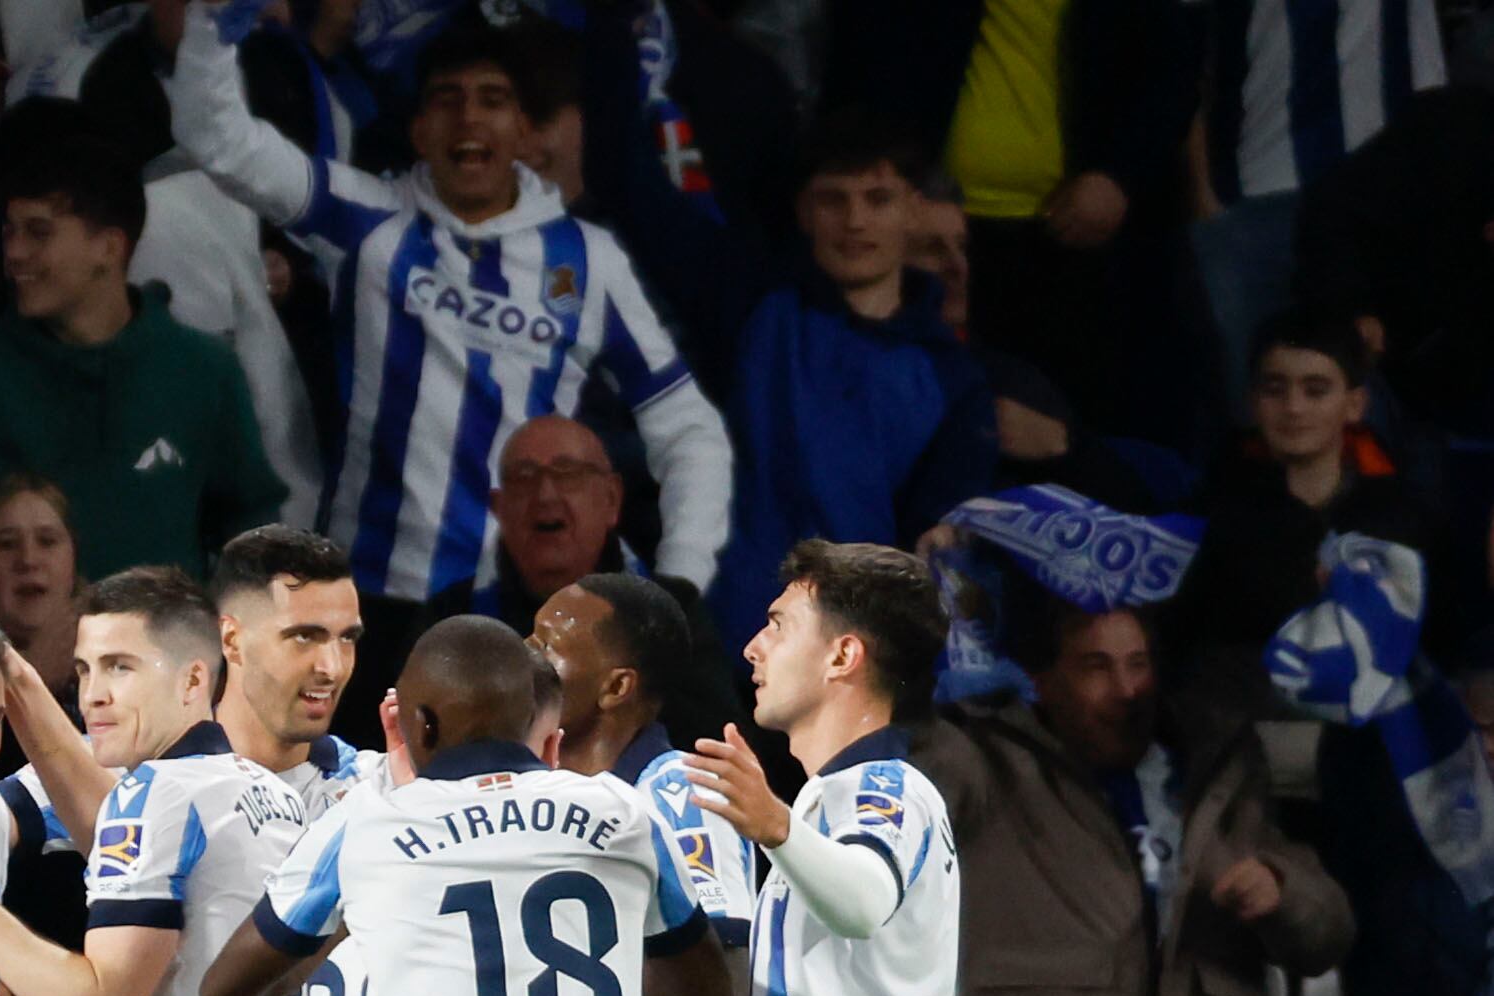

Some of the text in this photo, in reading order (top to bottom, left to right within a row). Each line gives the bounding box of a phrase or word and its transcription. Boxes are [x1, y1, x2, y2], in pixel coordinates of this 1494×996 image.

[411, 275, 556, 343] CAZOO
[234, 785, 304, 837] ZUBELD
[392, 797, 621, 859] H.TRAORÉ
